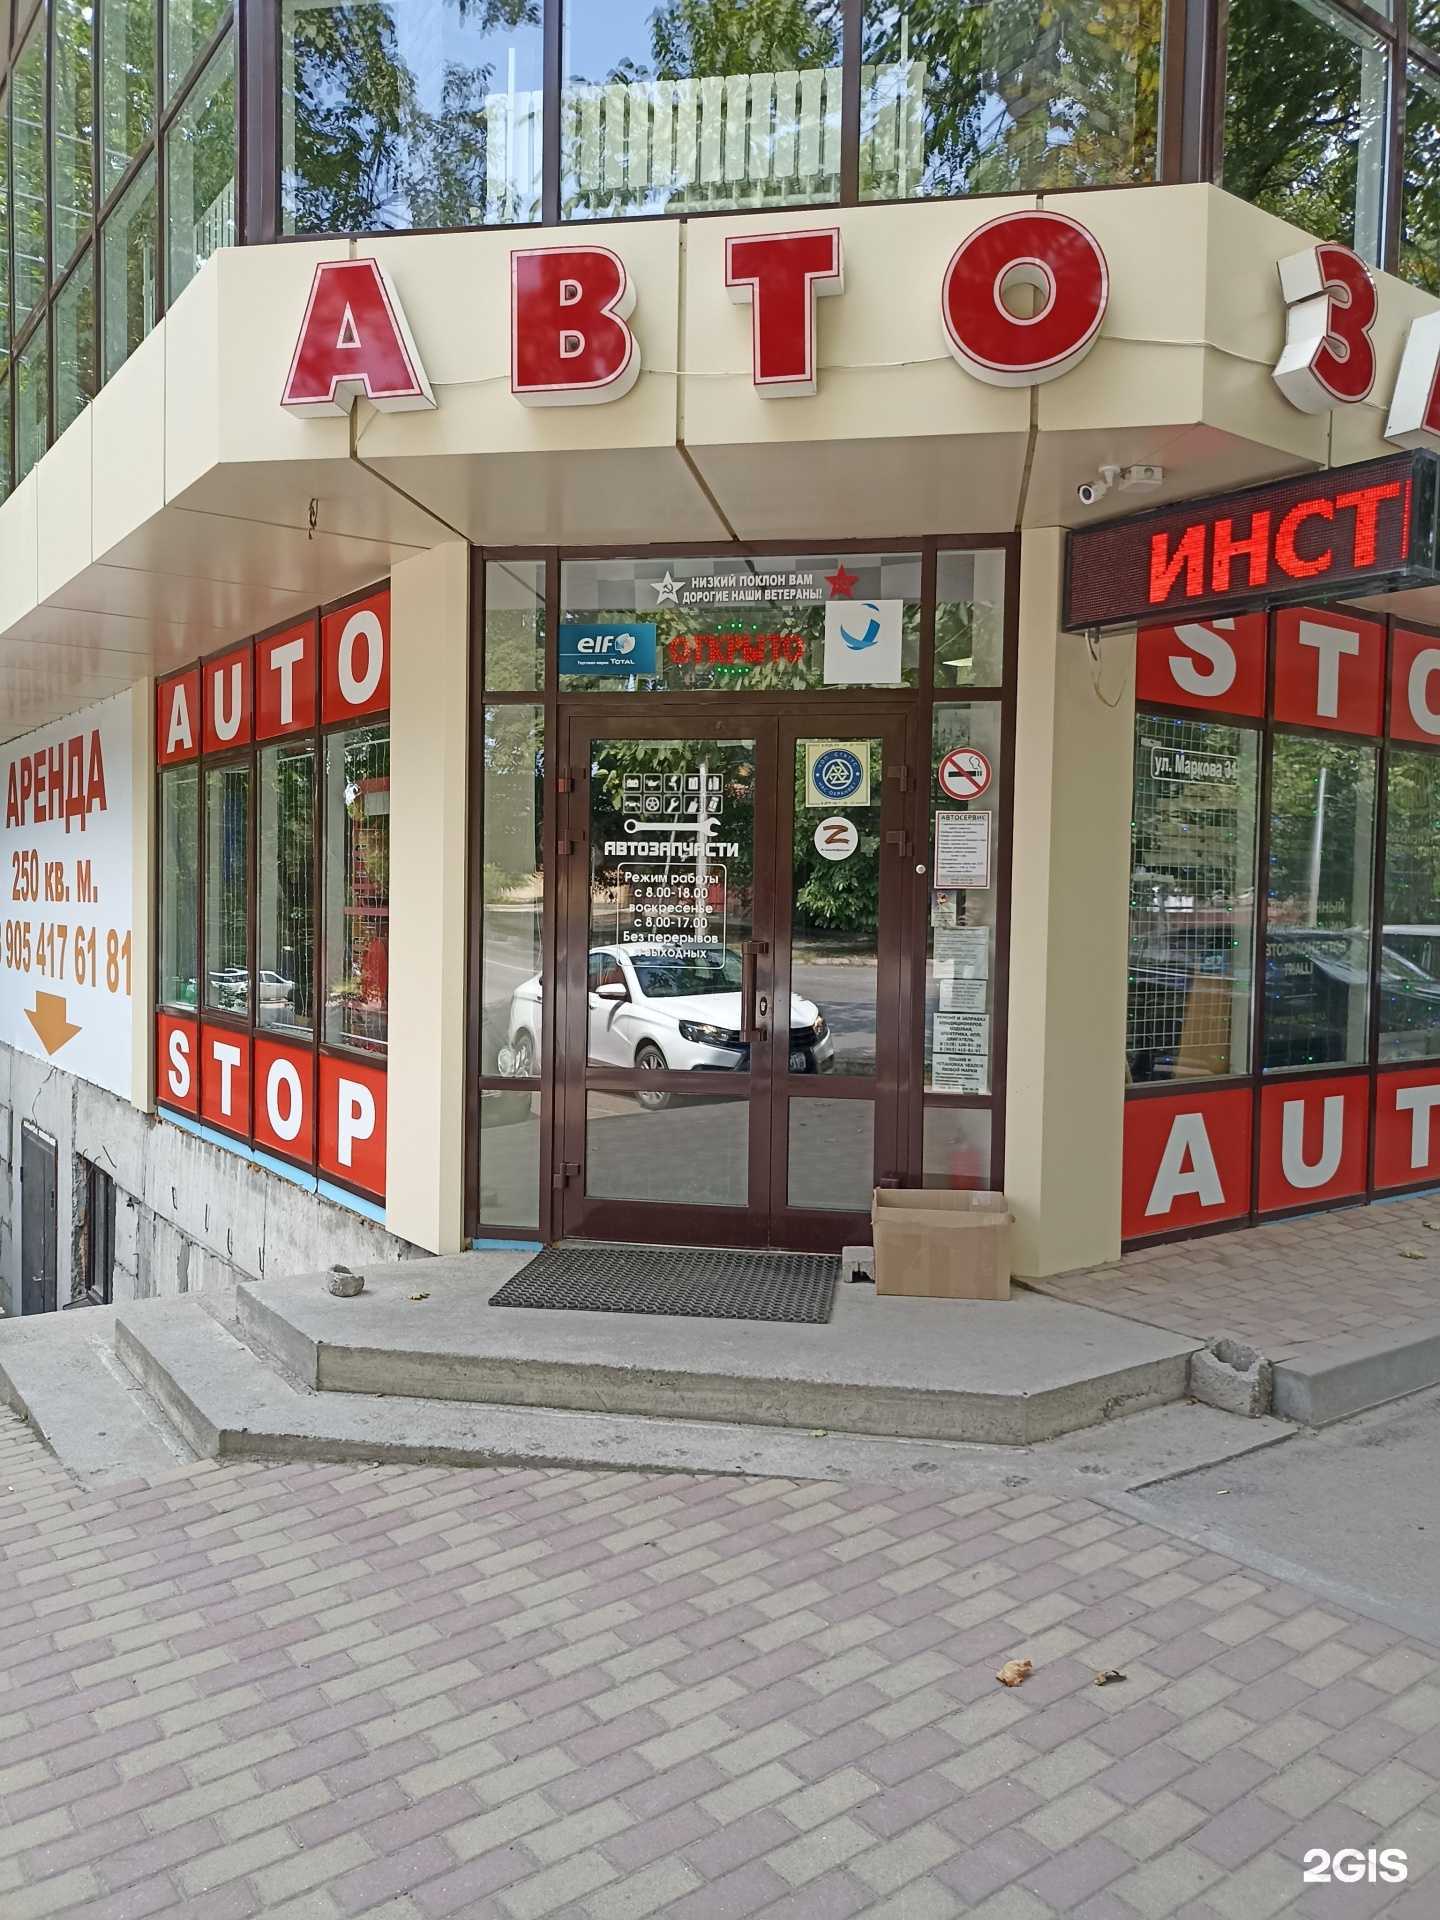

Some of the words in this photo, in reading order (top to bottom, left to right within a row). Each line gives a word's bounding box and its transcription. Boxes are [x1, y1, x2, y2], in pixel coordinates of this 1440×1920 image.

[691, 575, 737, 588] НИЗКИЙ
[739, 574, 786, 587] ПОКЛОН
[789, 573, 814, 585] ВАМ
[682, 590, 729, 604] ДОРОГИЕ
[731, 589, 762, 602] НАШИ
[764, 588, 823, 601] ВЕТЕРАНЫ!
[577, 635, 615, 653] elf
[667, 631, 806, 666] ОТКРЫТО
[166, 609, 385, 754] AUTO
[1154, 755, 1172, 776] ул.
[1175, 753, 1222, 780] Маркова
[5, 728, 108, 833] АРЕНДА
[822, 824, 851, 845] Z
[604, 841, 739, 858] АВТОЗАПЧАСТИ
[11, 849, 40, 903] 250
[624, 871, 668, 884] Режим
[671, 872, 719, 885] работы
[634, 889, 642, 898] с
[646, 887, 709, 899] 8.00-18.00
[629, 903, 713, 914] воскресенье
[634, 917, 642, 927] с
[645, 917, 708, 928] 8.00-17.00
[623, 931, 645, 942] Без
[647, 934, 719, 945] перерывов
[5, 917, 32, 974] 905
[36, 922, 69, 981] 417
[74, 925, 99, 988] 61
[106, 928, 133, 997] 81
[167, 1029, 377, 1167] STOP
